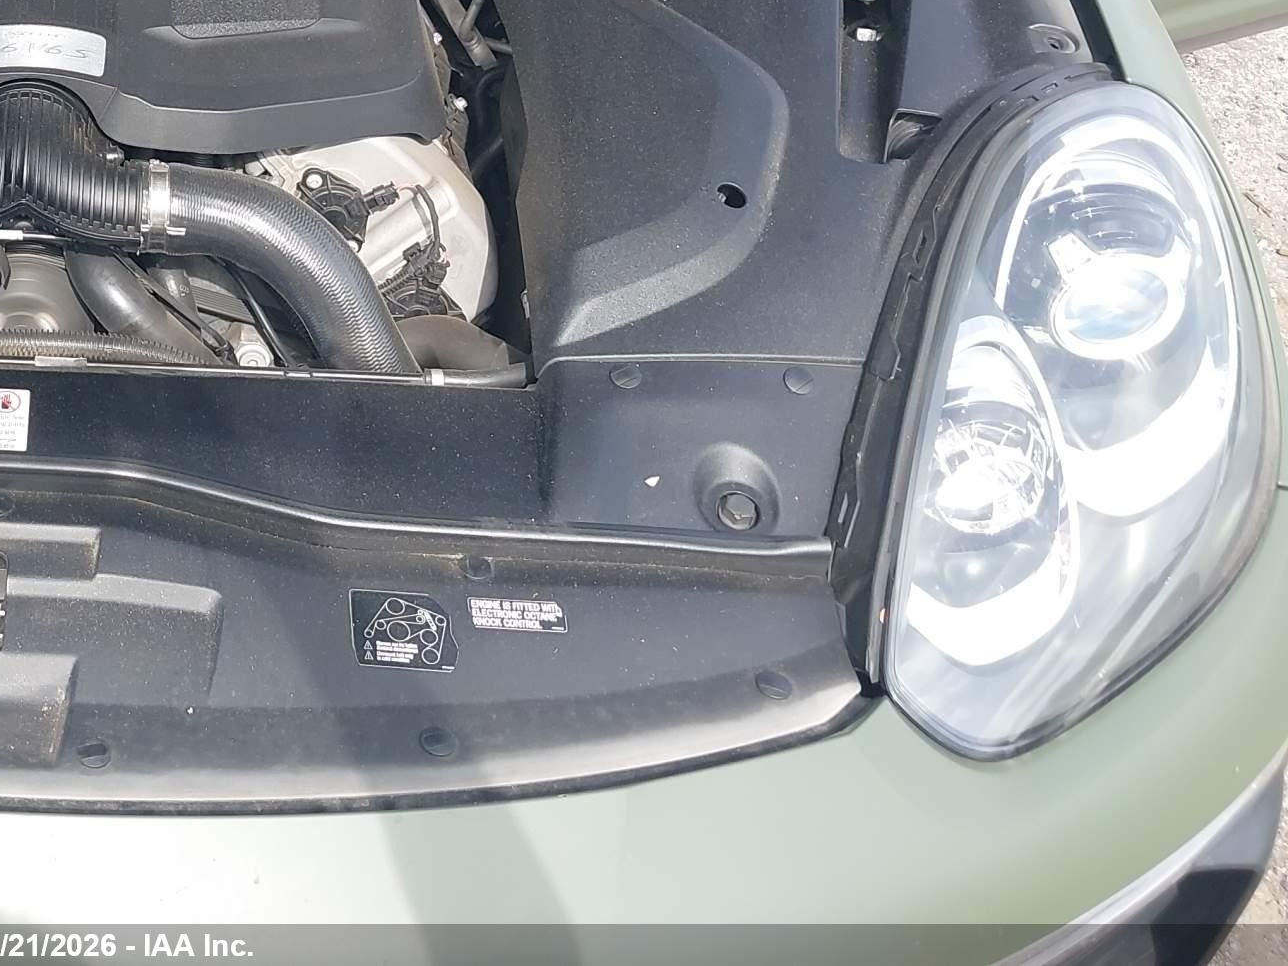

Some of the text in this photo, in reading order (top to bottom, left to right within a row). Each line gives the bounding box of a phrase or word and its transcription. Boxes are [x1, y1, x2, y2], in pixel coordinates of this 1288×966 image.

[470, 599, 501, 609] ENGINE
[502, 601, 511, 609] IS
[512, 602, 541, 611] FITTED
[472, 609, 522, 619] ELECTRONIC
[473, 617, 542, 629] KNOCK CONTROL
